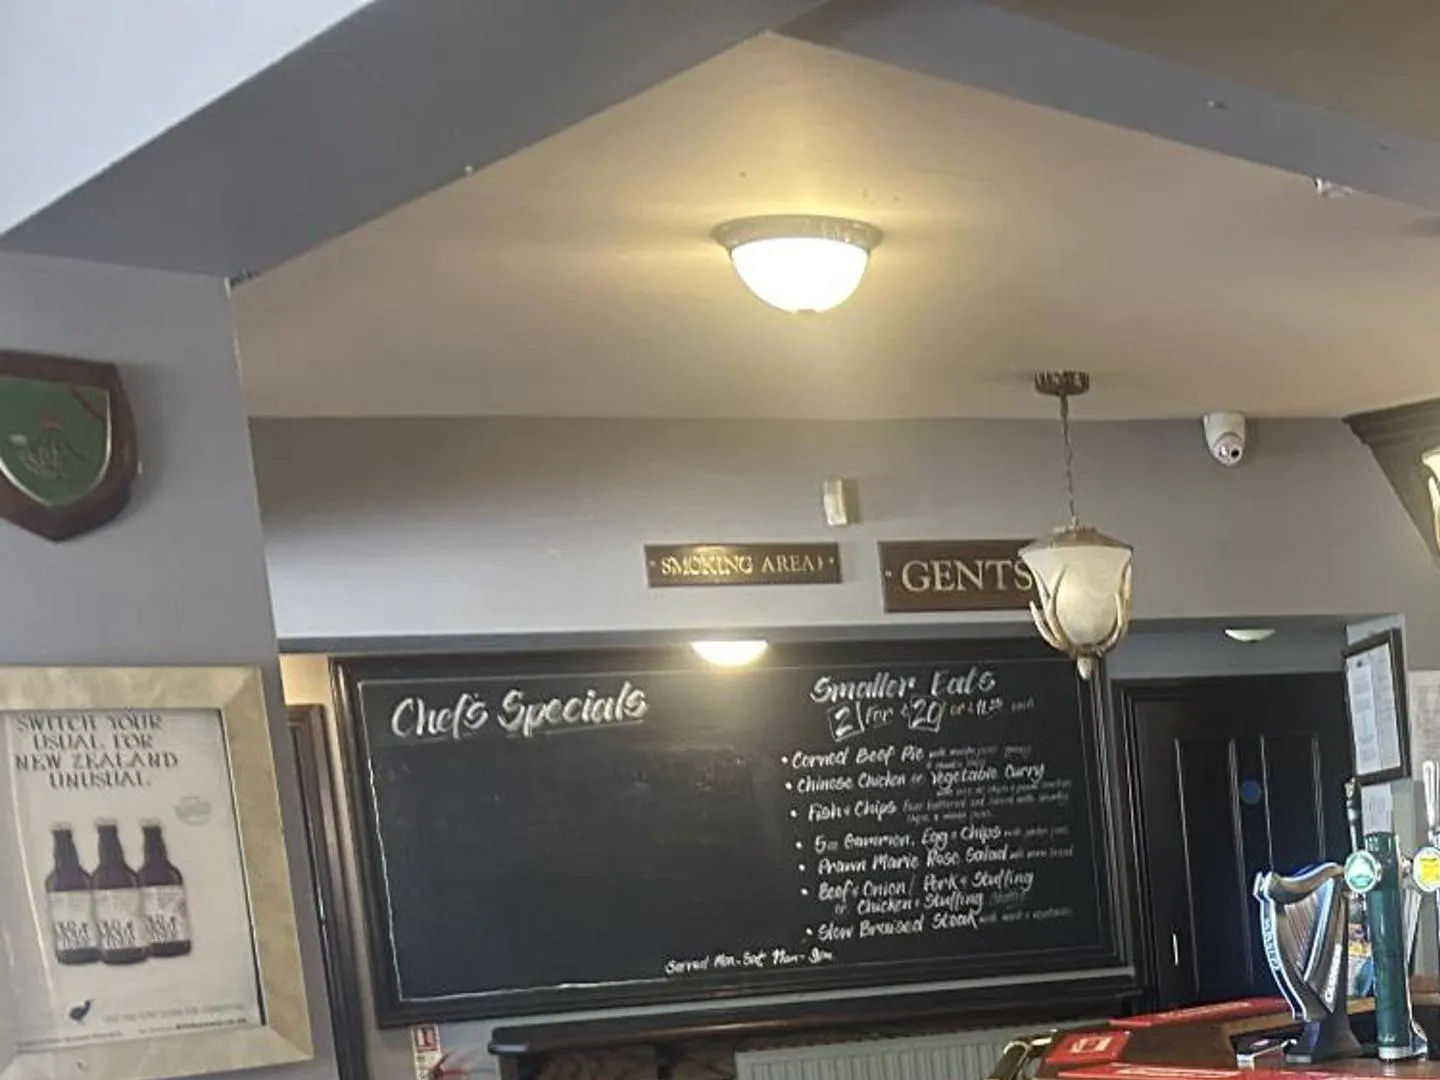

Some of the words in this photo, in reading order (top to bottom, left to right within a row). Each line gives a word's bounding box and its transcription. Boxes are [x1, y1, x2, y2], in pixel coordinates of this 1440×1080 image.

[661, 554, 754, 576] SMOKING
[902, 558, 1033, 593] GENTS
[810, 671, 917, 703] Smaller
[931, 667, 997, 698] Eats
[16, 713, 97, 731] SWITCH
[106, 713, 163, 731] YOUR
[497, 681, 648, 738] Specials
[834, 705, 854, 737] 2
[33, 733, 97, 751] USUAL
[113, 732, 154, 749] FOR
[15, 753, 61, 771] NEW
[71, 751, 180, 770] ZEALAND
[792, 750, 847, 768] Corned
[856, 745, 896, 767] Beef
[901, 744, 925, 762] Pie
[796, 776, 853, 794] Chinese
[858, 770, 906, 788] Chicken
[930, 767, 998, 790] Vegetable
[1003, 763, 1046, 784] Curry
[808, 802, 843, 822] Fish
[854, 800, 897, 822] Chips
[921, 828, 949, 850] Egg
[960, 824, 1002, 844] Chips
[818, 857, 867, 875] Prawn
[872, 851, 920, 870] Marie
[926, 849, 962, 867] Rose
[965, 843, 1009, 863] Salad
[818, 879, 853, 904] Beef
[863, 880, 906, 897] Onion
[923, 874, 960, 893] Pork
[971, 867, 1035, 893] Stuffing
[856, 898, 913, 916] Chicken
[923, 889, 984, 915] Stuffing
[818, 920, 855, 941] Slow
[932, 911, 979, 930] Steak
[664, 954, 710, 975] Served
